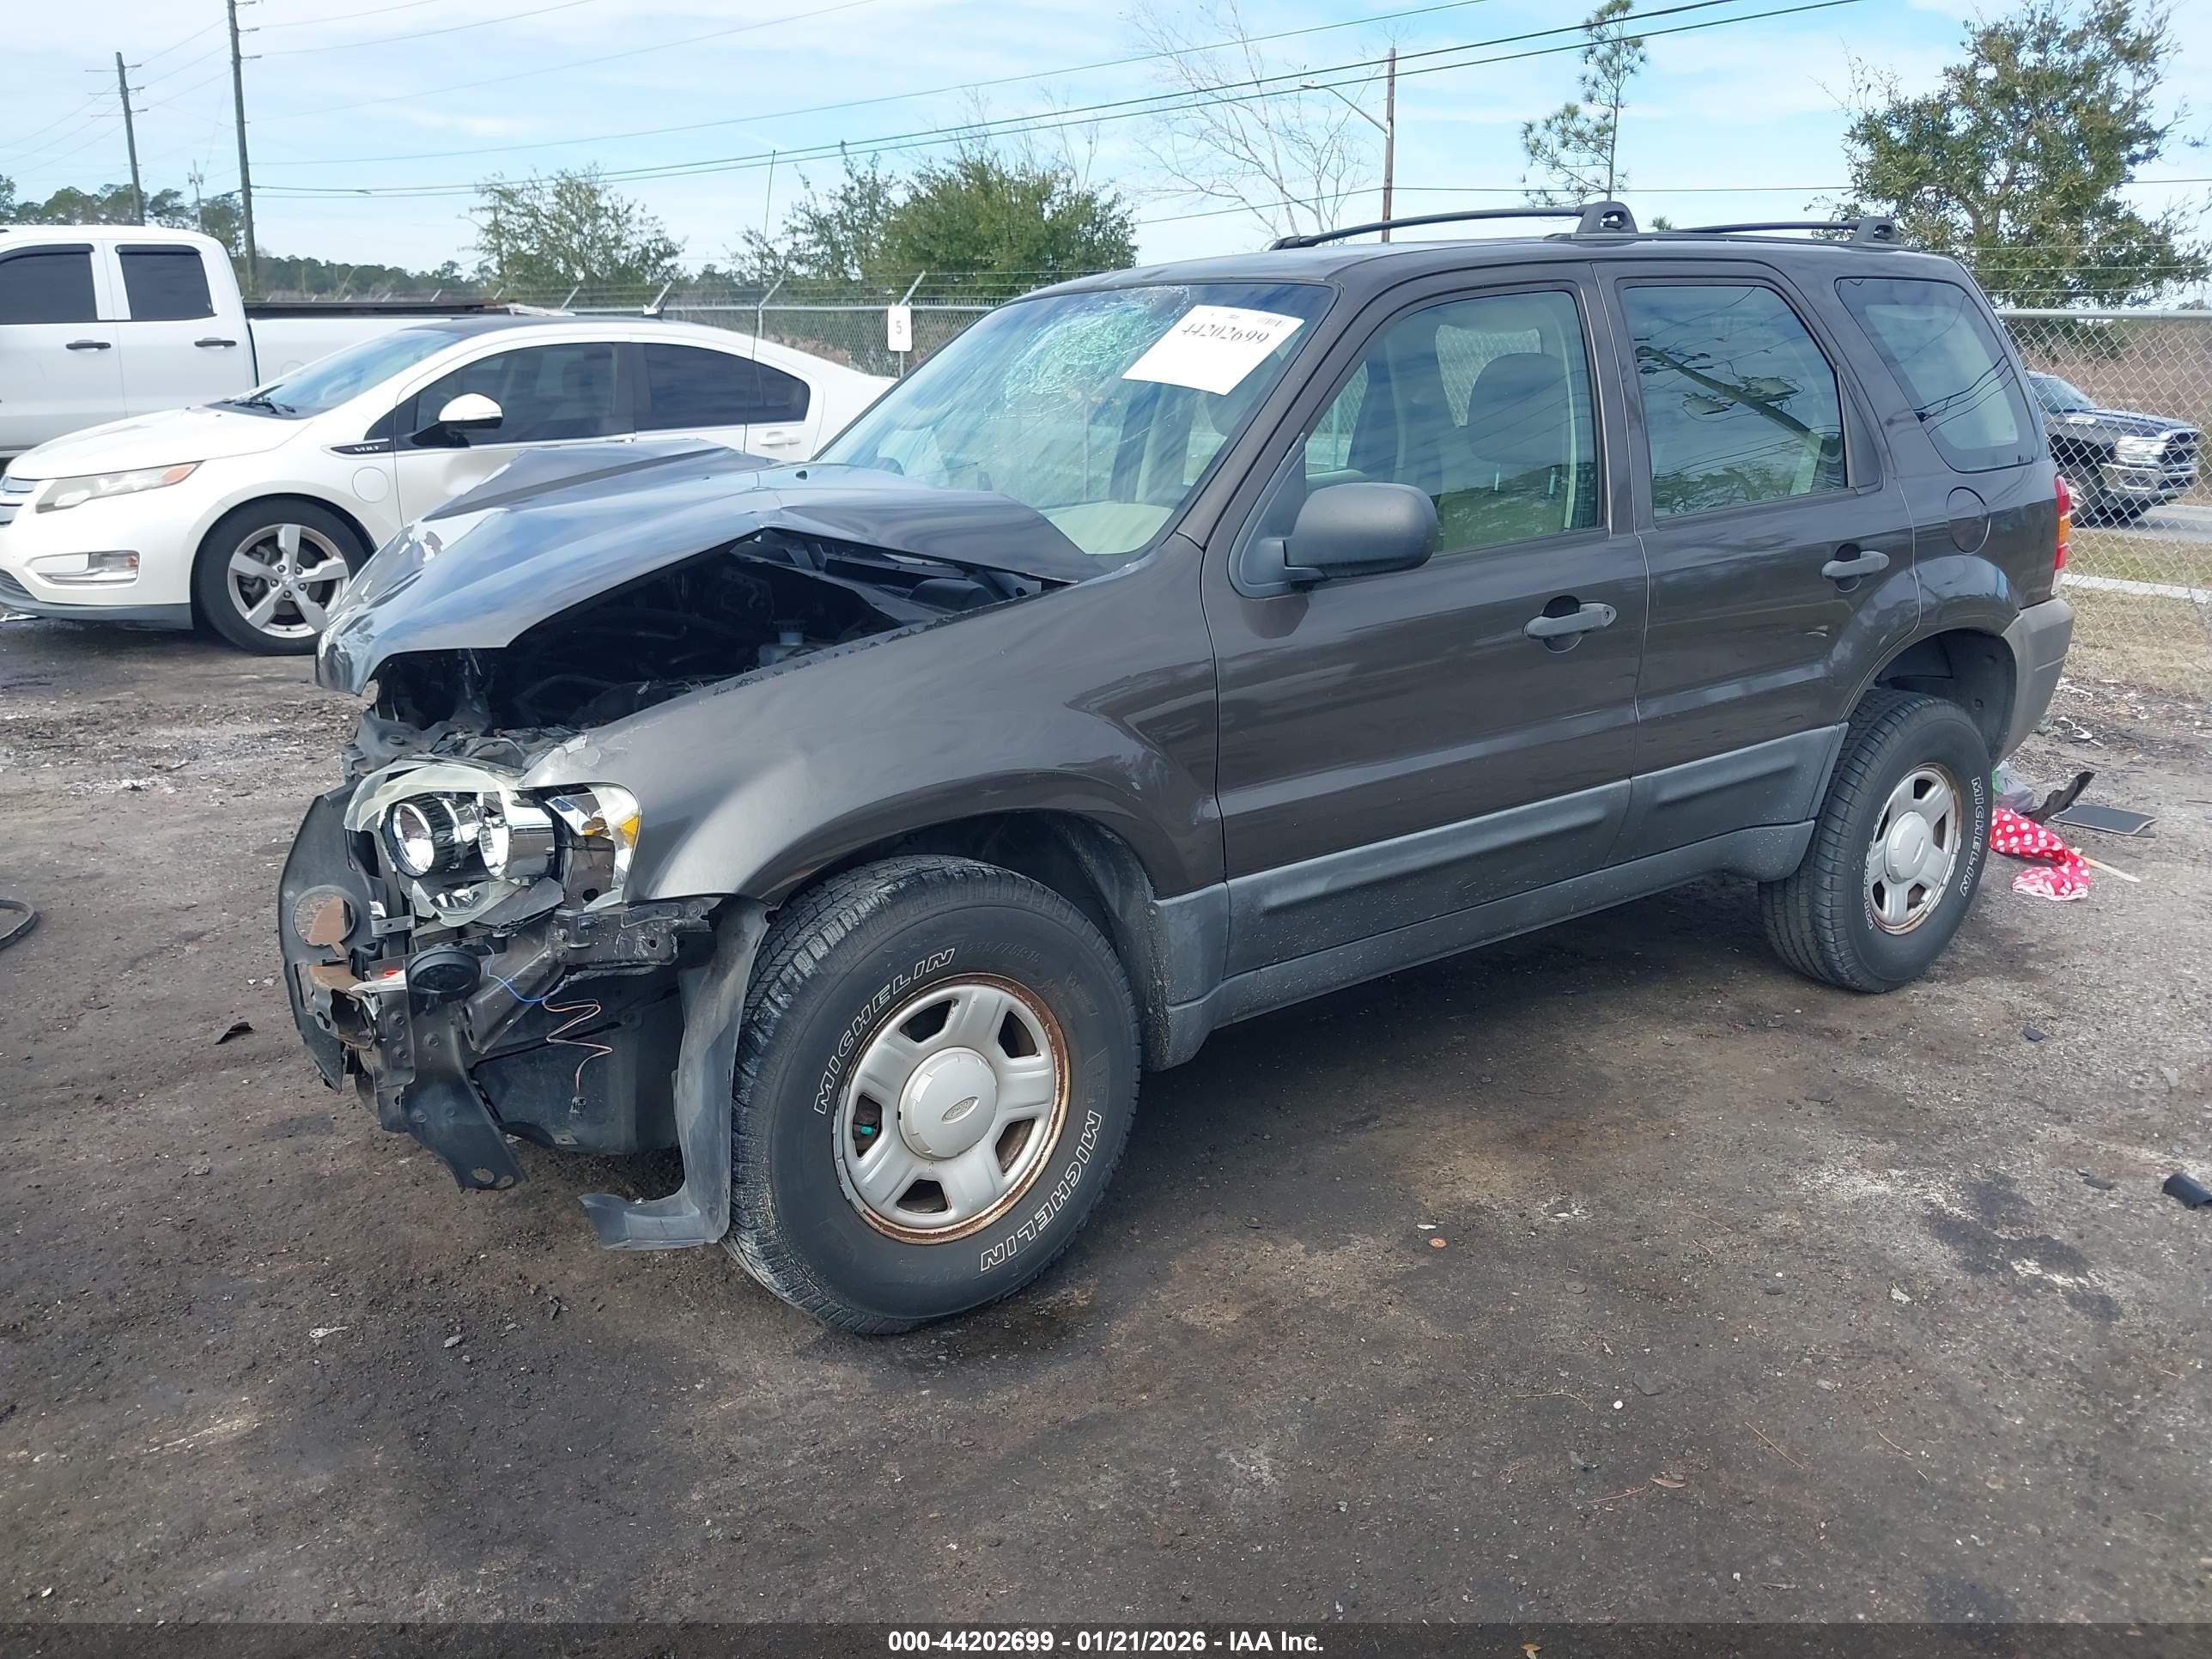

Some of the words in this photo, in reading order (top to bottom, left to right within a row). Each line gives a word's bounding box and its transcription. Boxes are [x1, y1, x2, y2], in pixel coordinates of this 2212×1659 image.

[896, 320, 902, 335] 5
[1182, 322, 1270, 344] 44202699
[1960, 776, 1985, 897] MICHELIN
[813, 948, 956, 1115] MICHELIN
[980, 1109, 1103, 1273] MICHELIN
